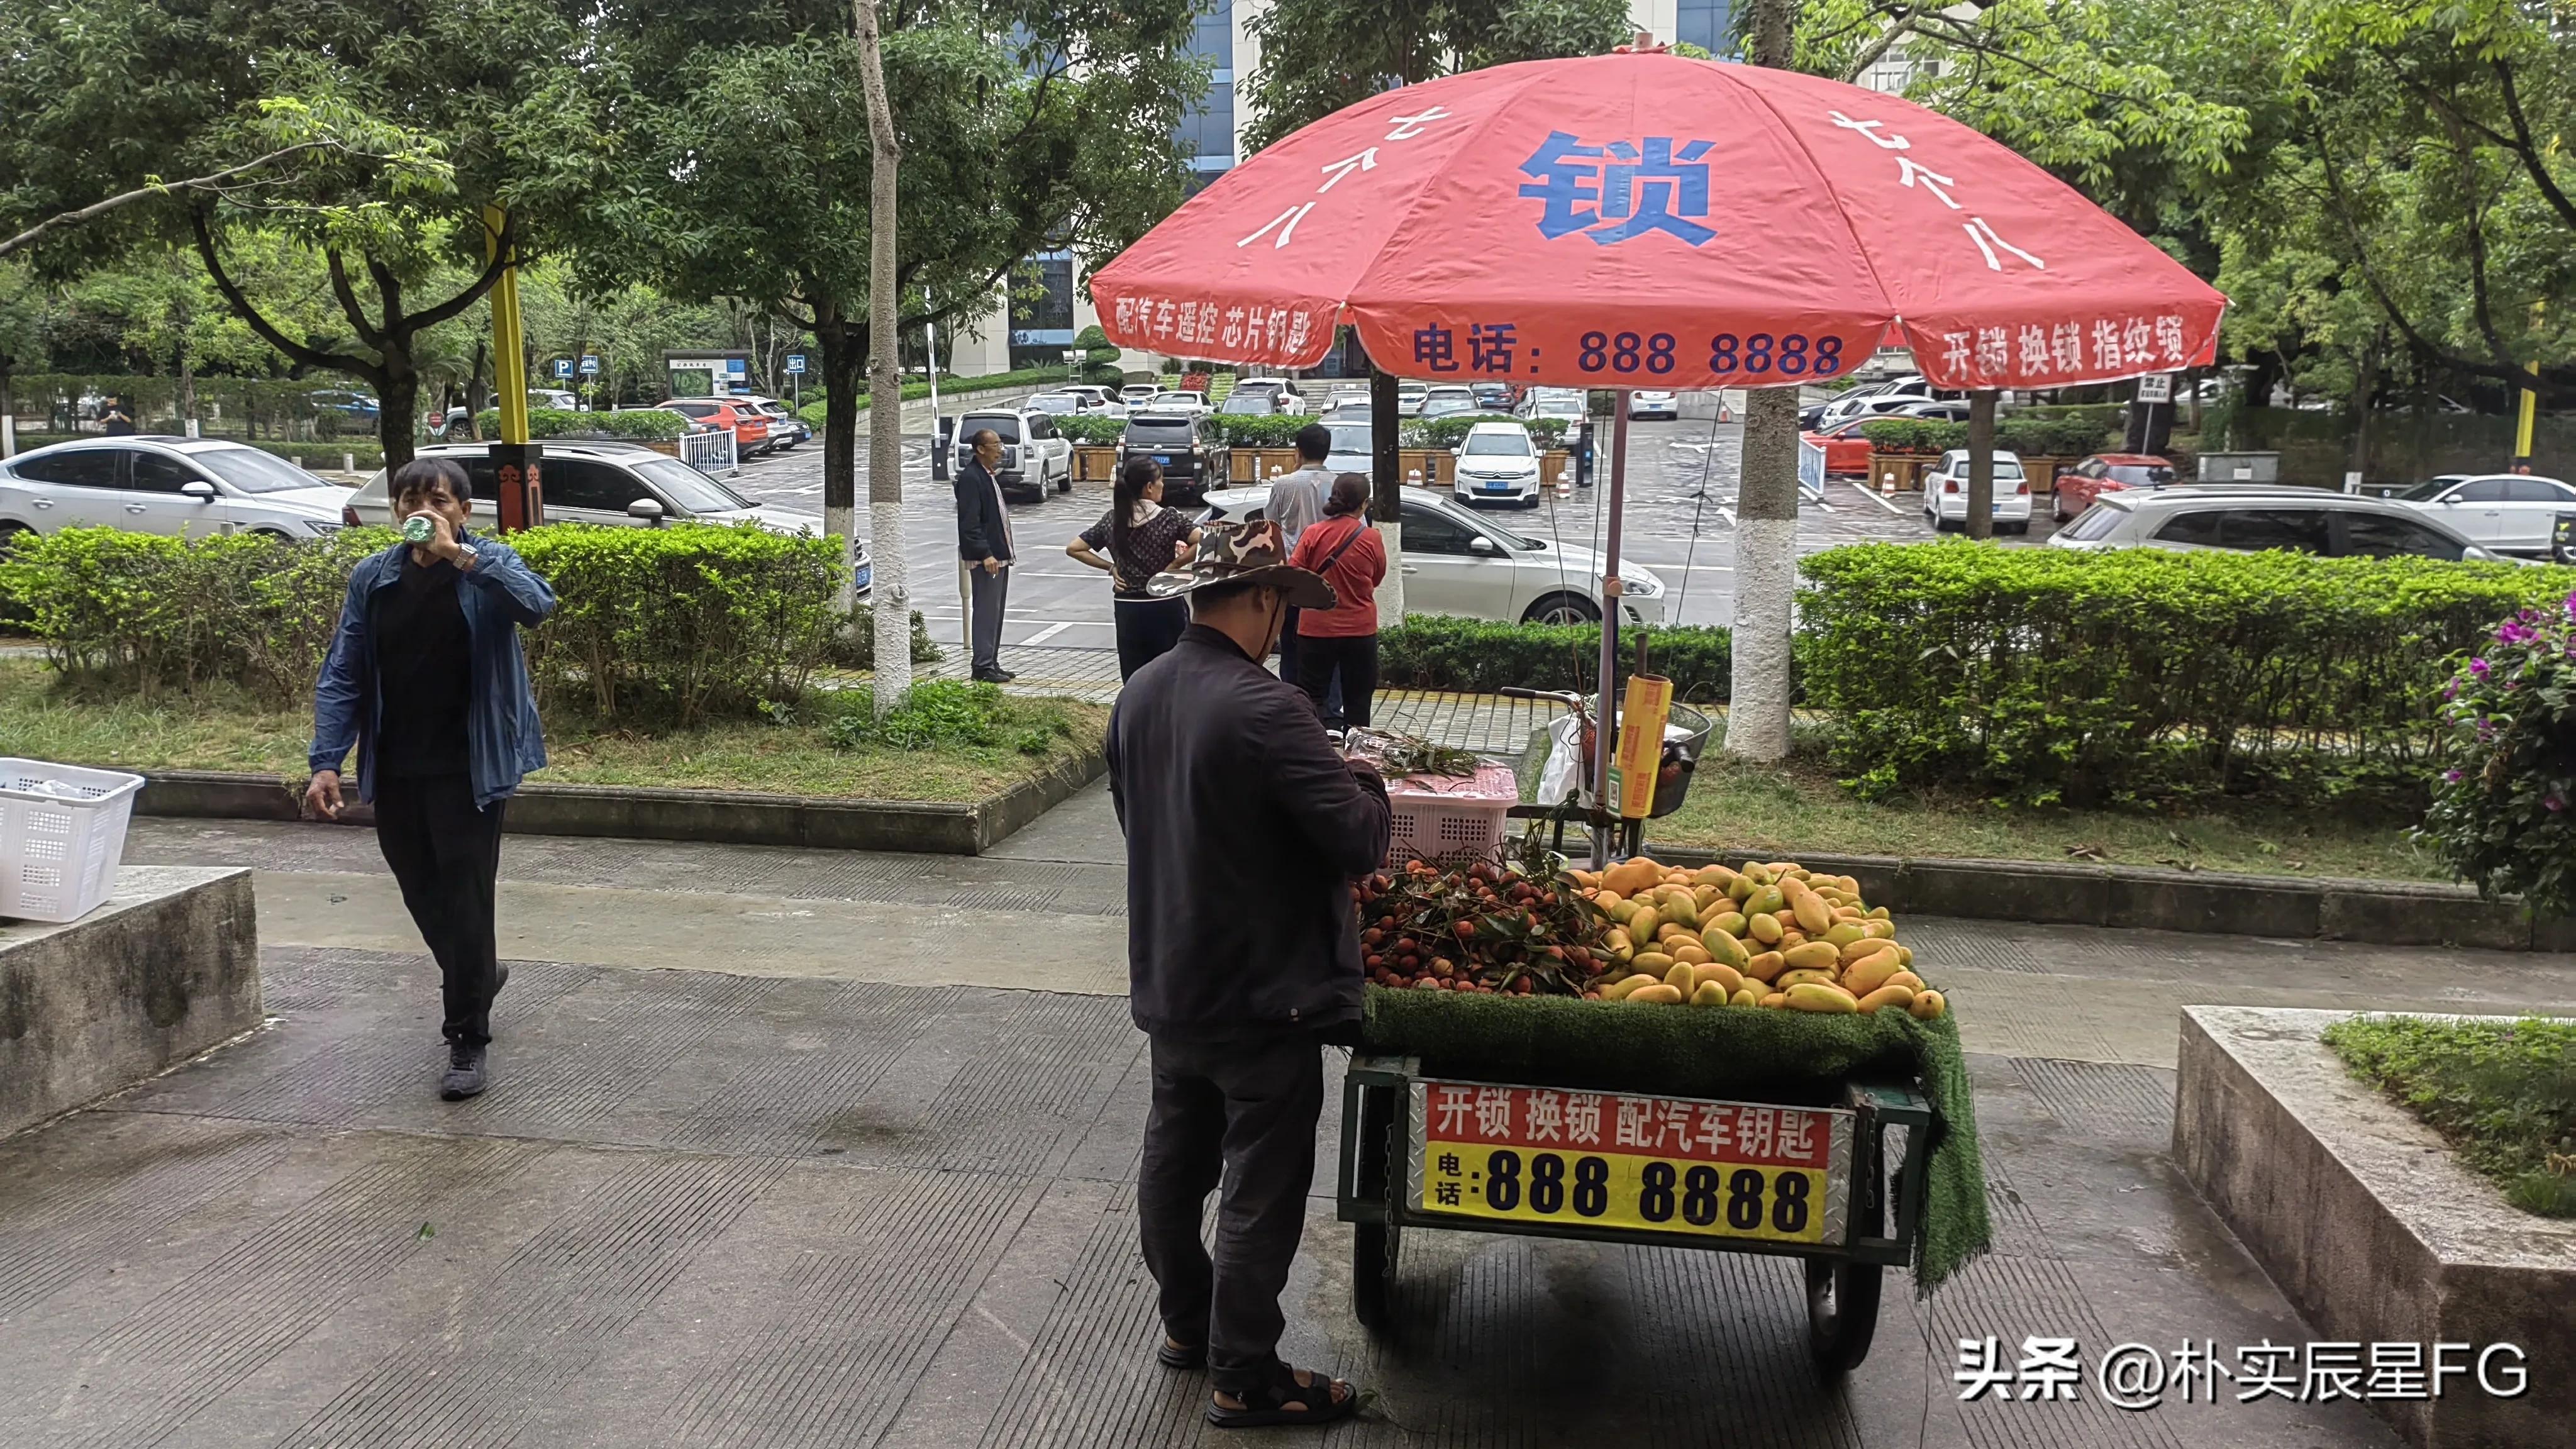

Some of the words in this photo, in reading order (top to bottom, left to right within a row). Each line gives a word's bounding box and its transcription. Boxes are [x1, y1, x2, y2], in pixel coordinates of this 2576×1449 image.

[1517, 130, 1719, 248] 锁
[1115, 296, 1219, 345] 配汽车遥控
[1221, 306, 1313, 357] 芯片钥匙
[1578, 330, 1677, 374] 888
[1709, 333, 1843, 375] 8888
[1942, 326, 2008, 382] 开锁
[2018, 319, 2083, 377] 换锁
[2091, 314, 2184, 370] 指纹锁
[558, 361, 569, 373] P
[789, 357, 803, 370] 出口
[1436, 1085, 1511, 1140] 开锁
[1525, 1089, 1602, 1148] 换锁
[1614, 1096, 1814, 1160] 配汽车钥匙
[1485, 1149, 1610, 1219] 888
[1638, 1161, 1810, 1233] 8888
